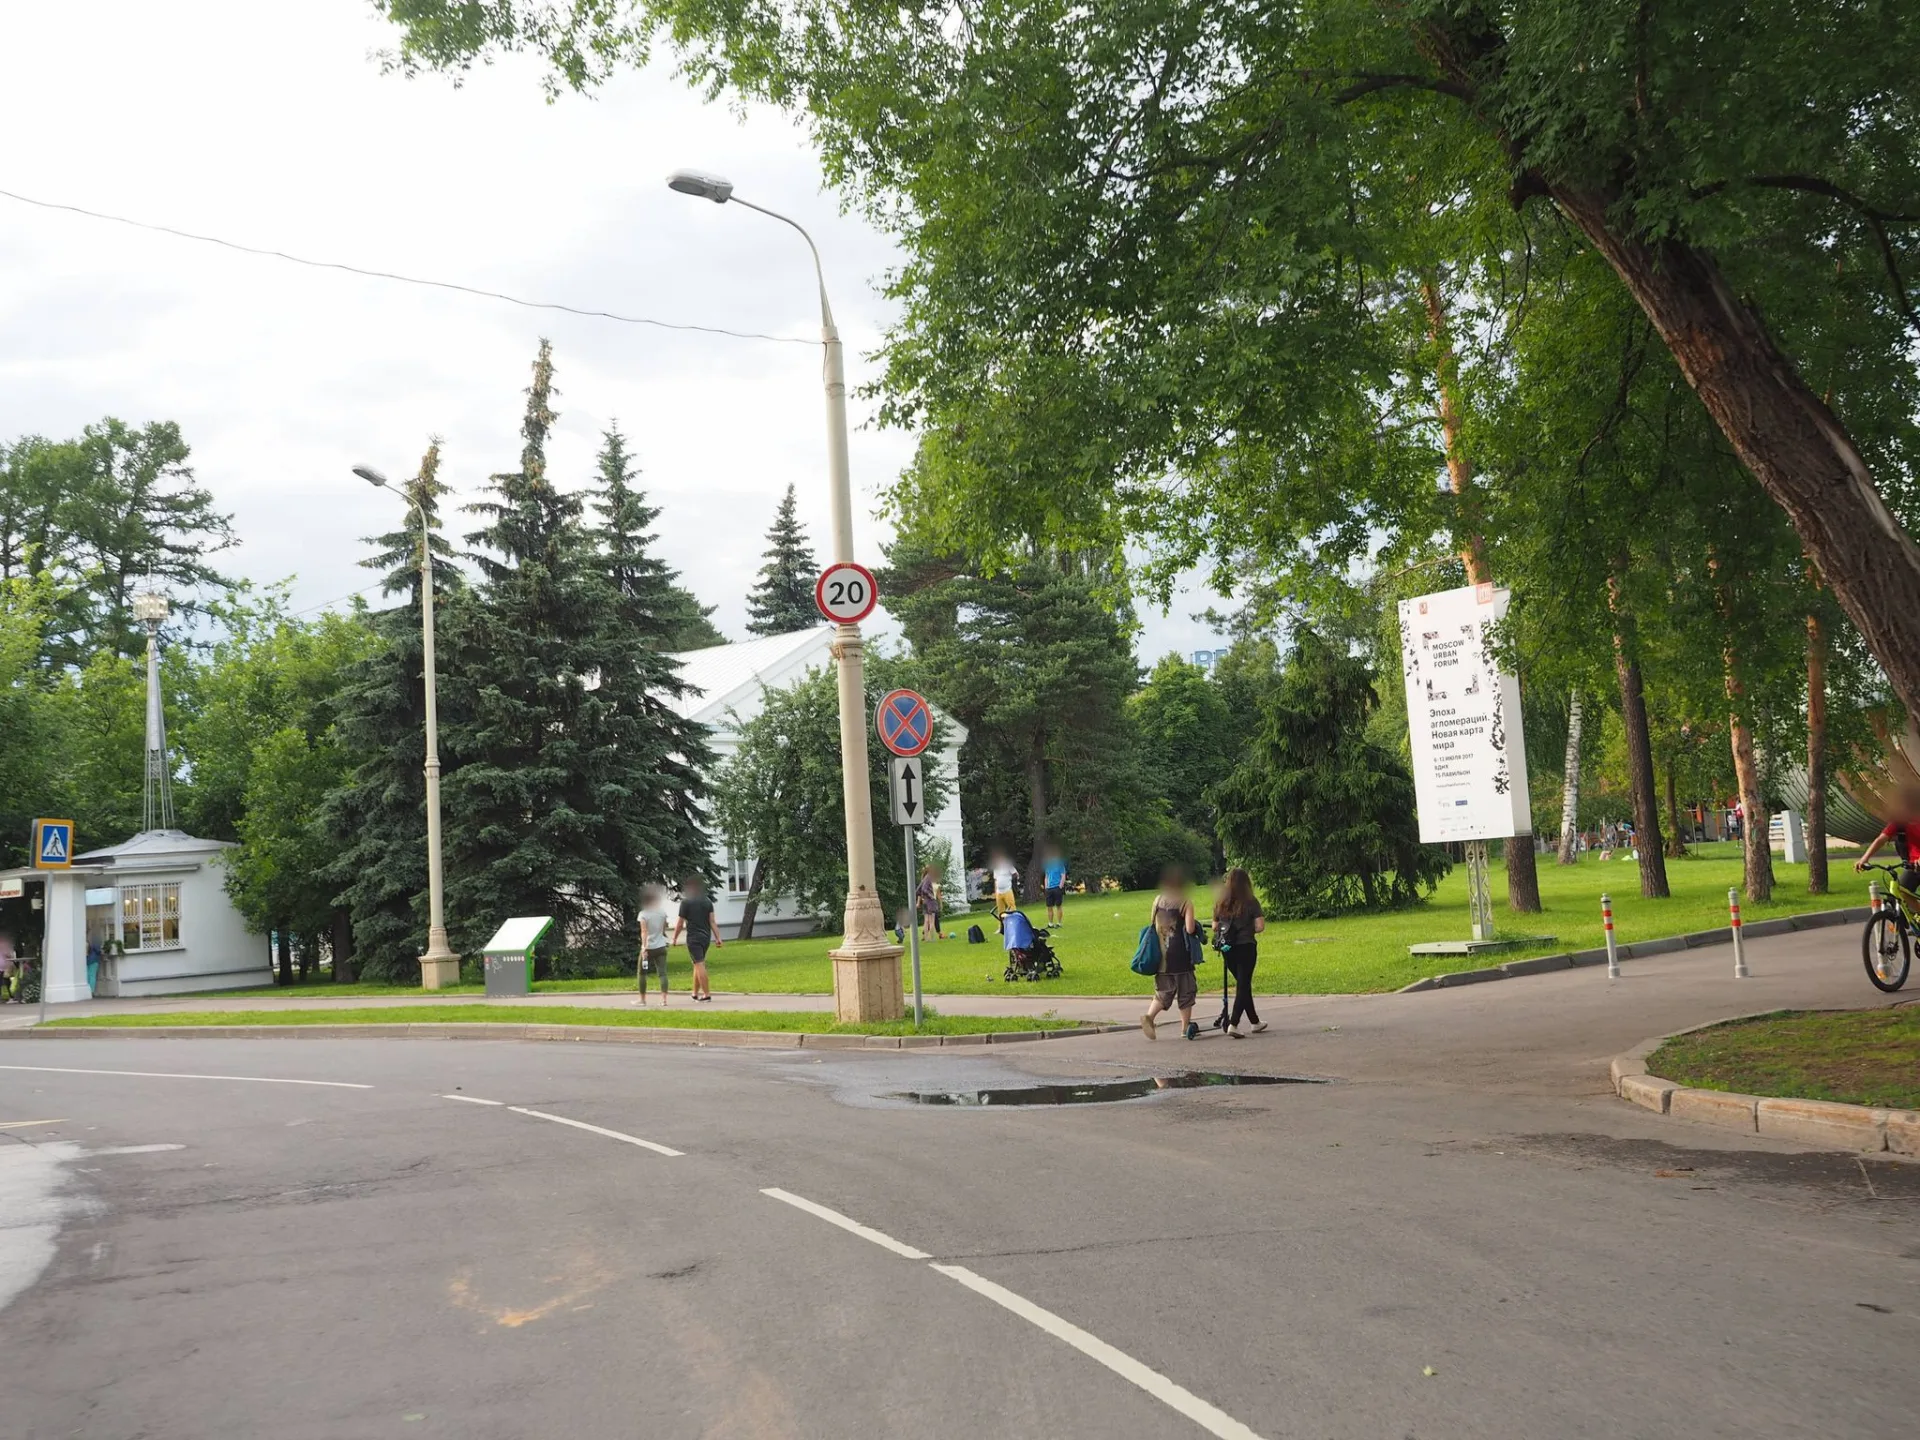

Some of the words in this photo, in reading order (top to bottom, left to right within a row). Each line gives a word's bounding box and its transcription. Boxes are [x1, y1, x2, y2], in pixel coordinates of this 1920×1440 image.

[829, 580, 864, 605] 20
[1432, 640, 1464, 650] MOSCOW
[1433, 650, 1457, 659] URBAN
[1433, 658, 1459, 668] FORUM
[1429, 708, 1456, 718] Эпоха
[1431, 712, 1490, 728] агломераций.
[1431, 730, 1458, 739] Новая
[1459, 726, 1484, 737] карта
[1432, 741, 1455, 751] мира
